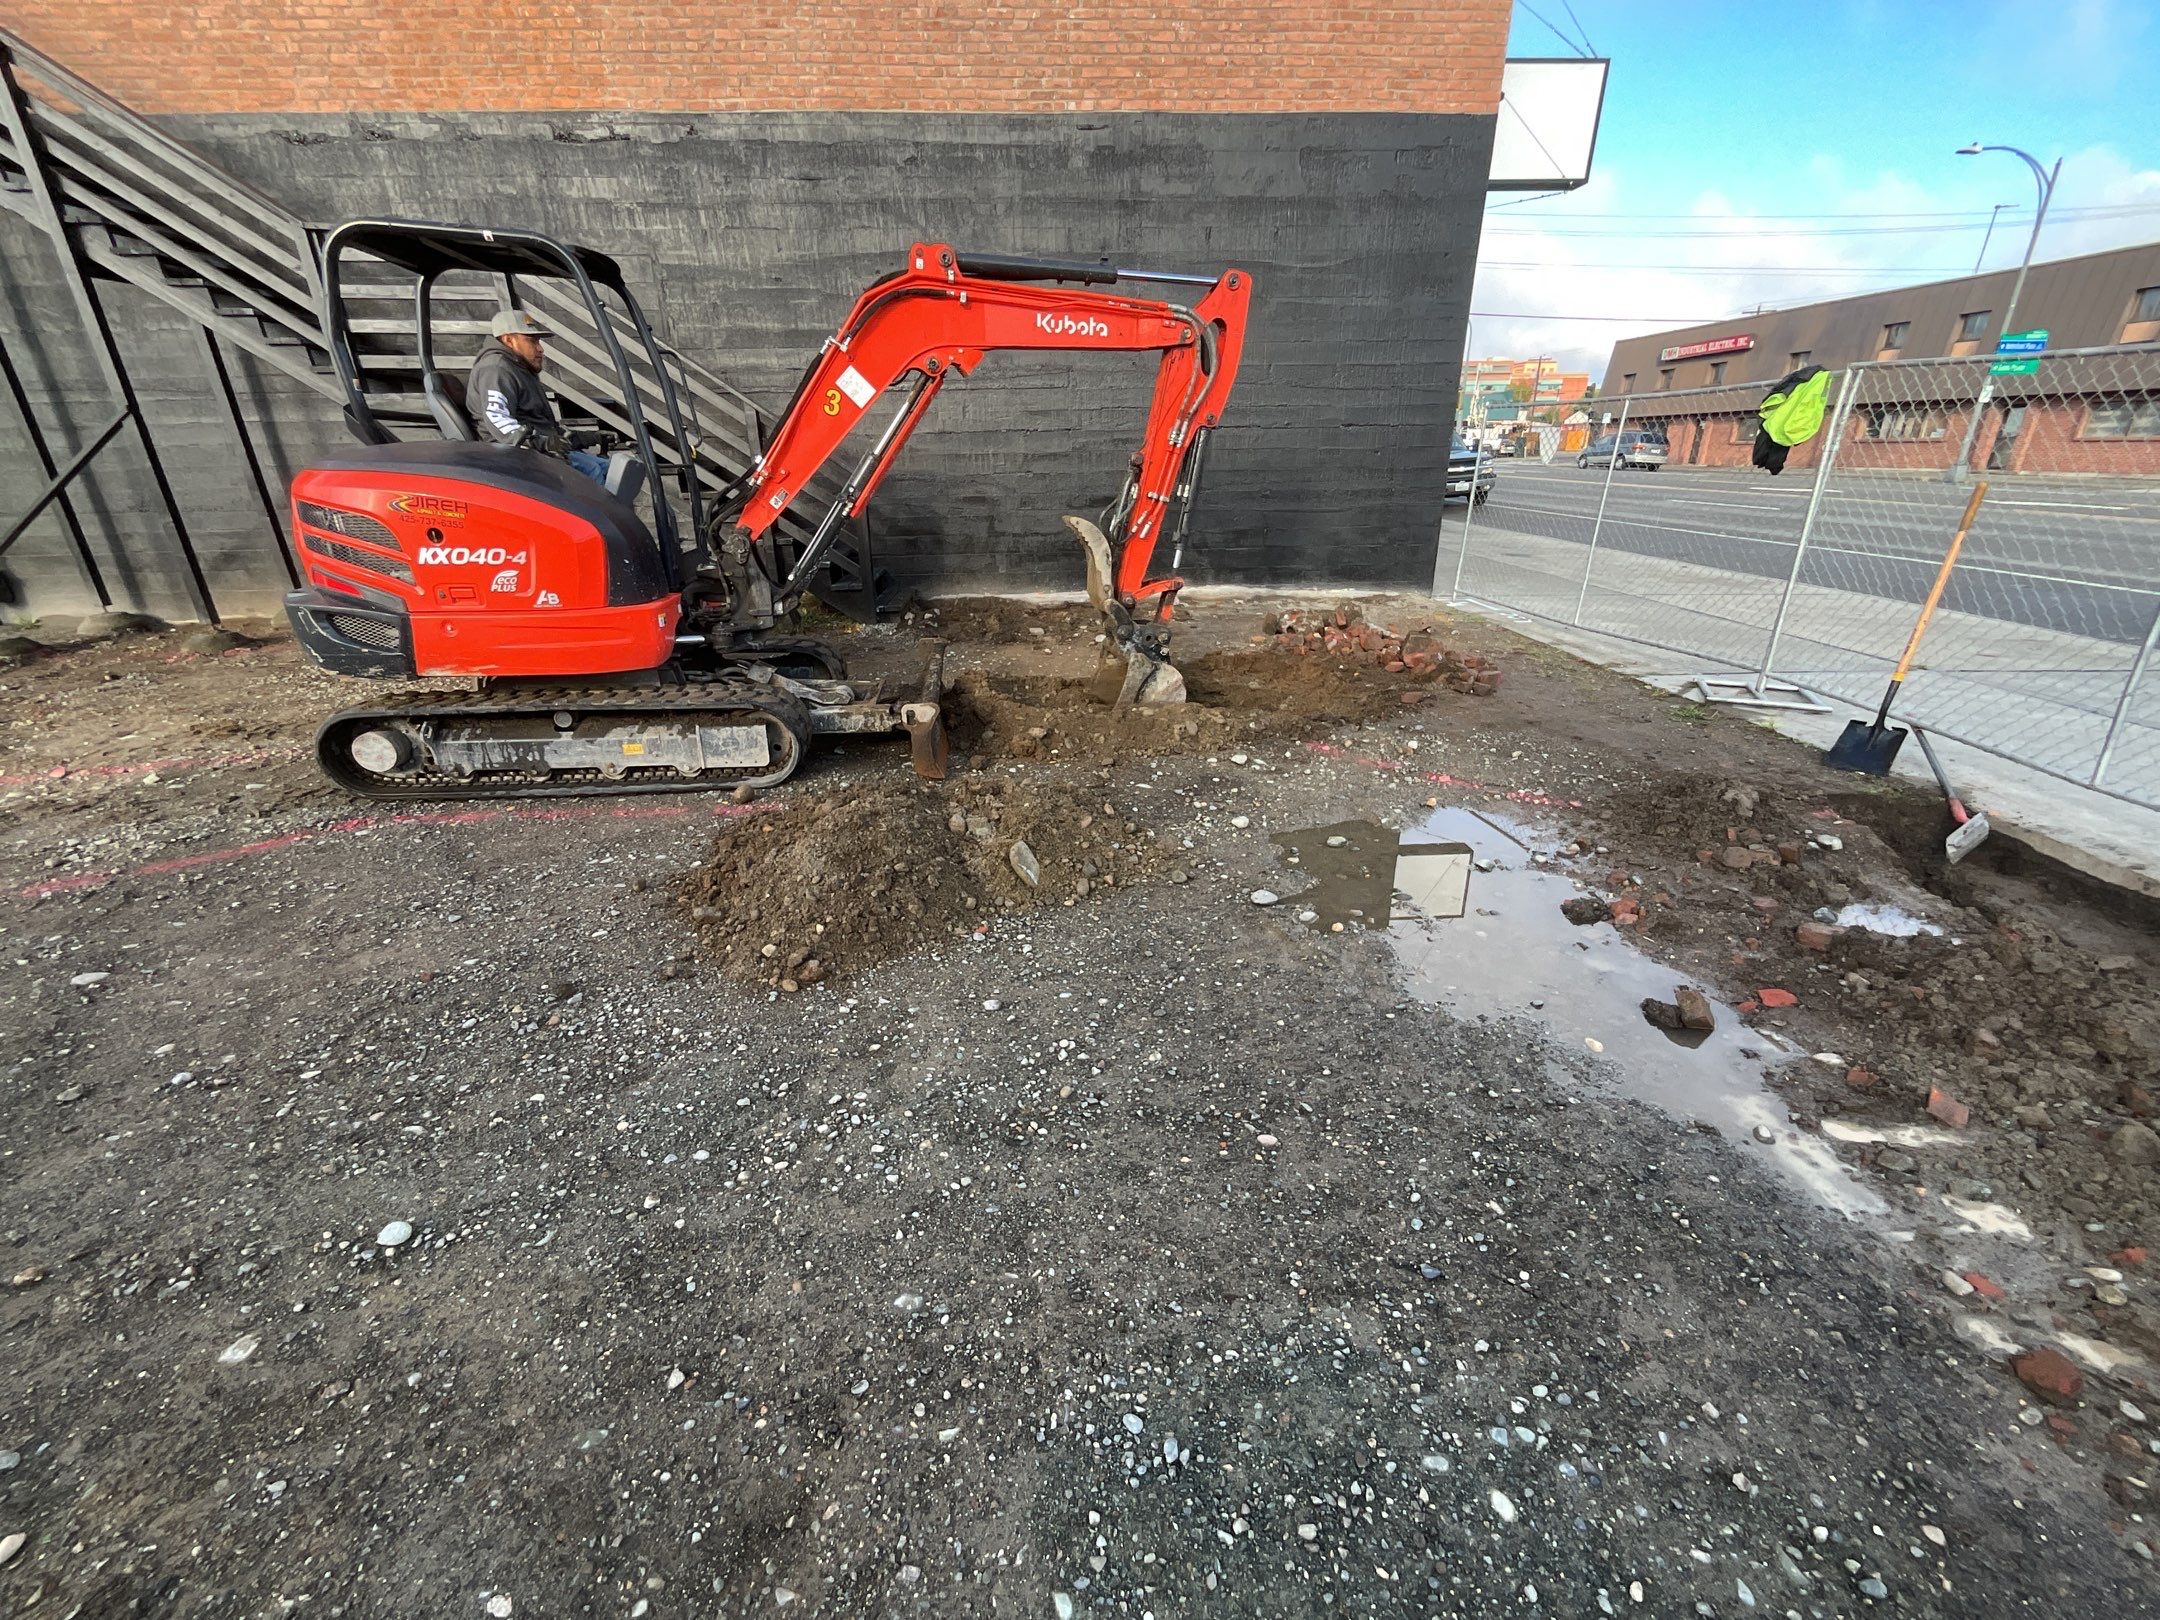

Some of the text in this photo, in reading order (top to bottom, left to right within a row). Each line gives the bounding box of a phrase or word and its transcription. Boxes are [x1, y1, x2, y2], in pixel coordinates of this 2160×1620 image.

[1036, 312, 1108, 337] Kubota
[823, 388, 842, 416] 3
[407, 496, 469, 513] JIREH
[418, 547, 528, 565] KX040-4
[491, 584, 517, 592] PLUS
[497, 576, 518, 585] eco
